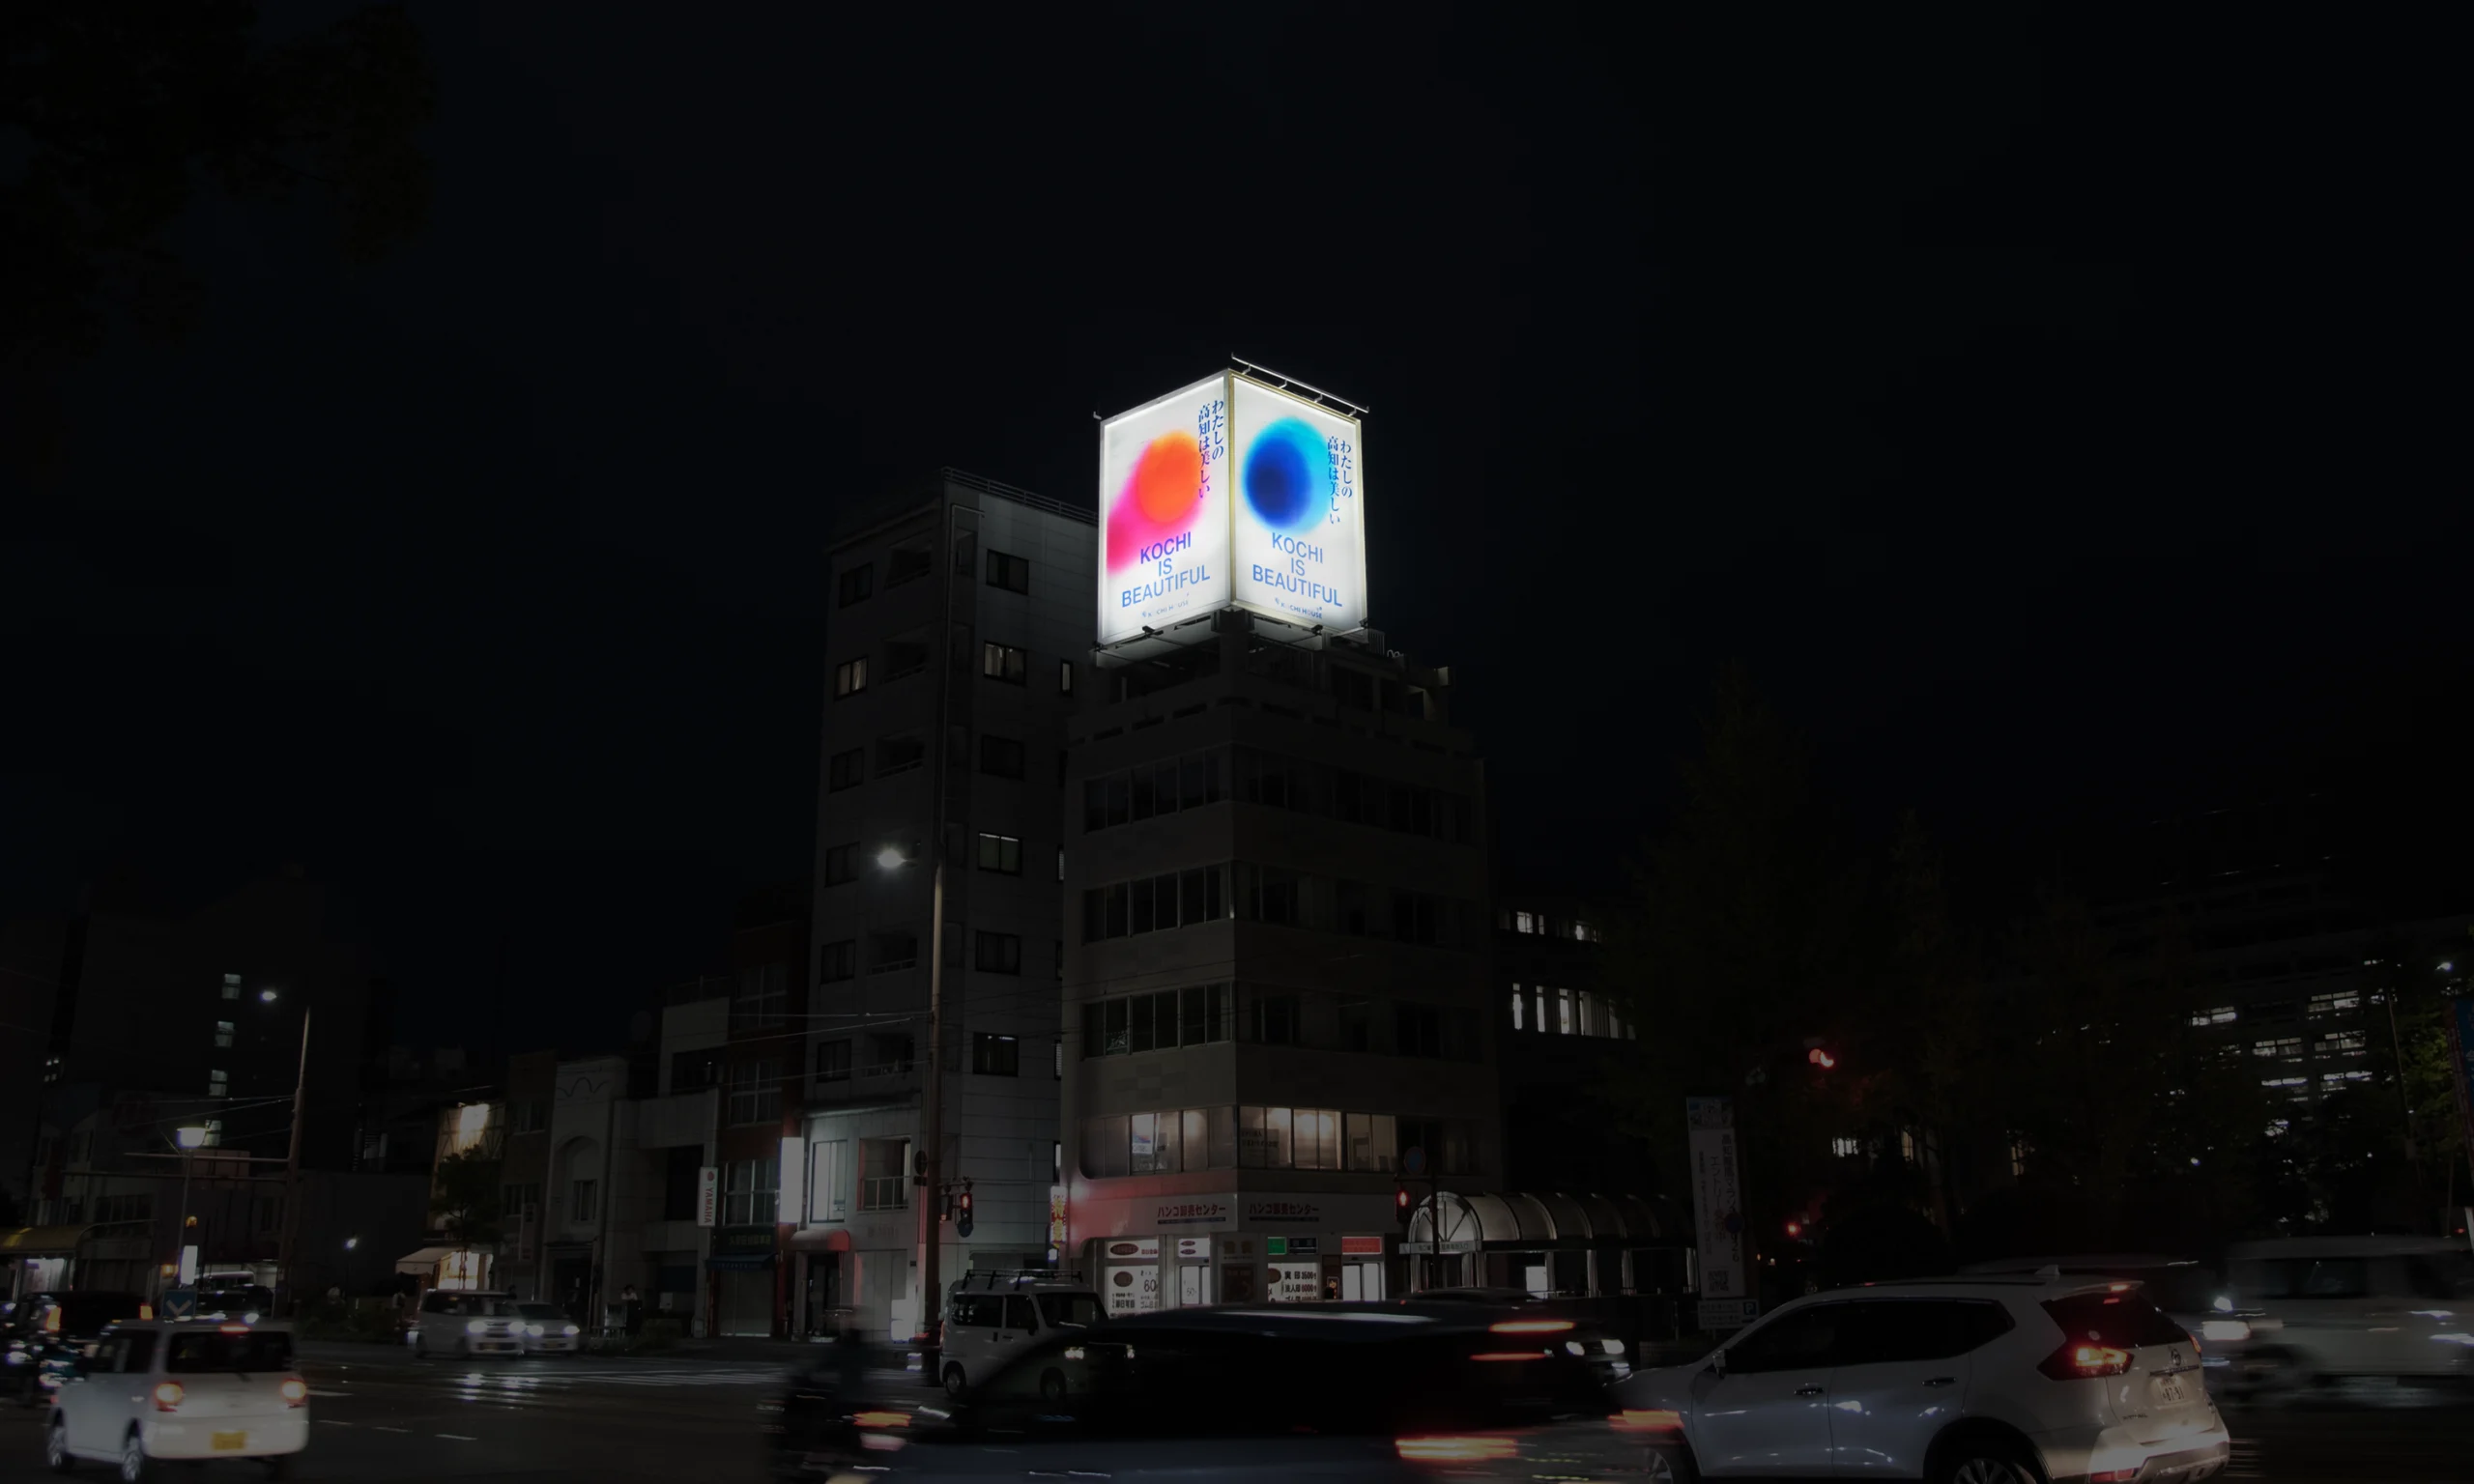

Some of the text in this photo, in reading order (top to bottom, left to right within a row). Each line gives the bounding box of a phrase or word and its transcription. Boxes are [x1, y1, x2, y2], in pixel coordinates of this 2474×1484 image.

[1212, 399, 1224, 459] わたしの
[1198, 404, 1210, 499] 高知は美しい
[1340, 441, 1353, 499] わたしの
[1327, 435, 1340, 525] 高知は美しい
[1140, 531, 1192, 564] KOCHI
[1272, 532, 1324, 564] KOCHI
[1158, 557, 1172, 577] IS
[1290, 556, 1306, 577] IS
[1121, 564, 1211, 608] BEAUTIFUL
[1252, 564, 1343, 607] BEAUTIFUL
[1148, 600, 1190, 617] KCHI HUSE
[1280, 602, 1301, 613] KCHI
[704, 1186, 713, 1223] YAMAHA
